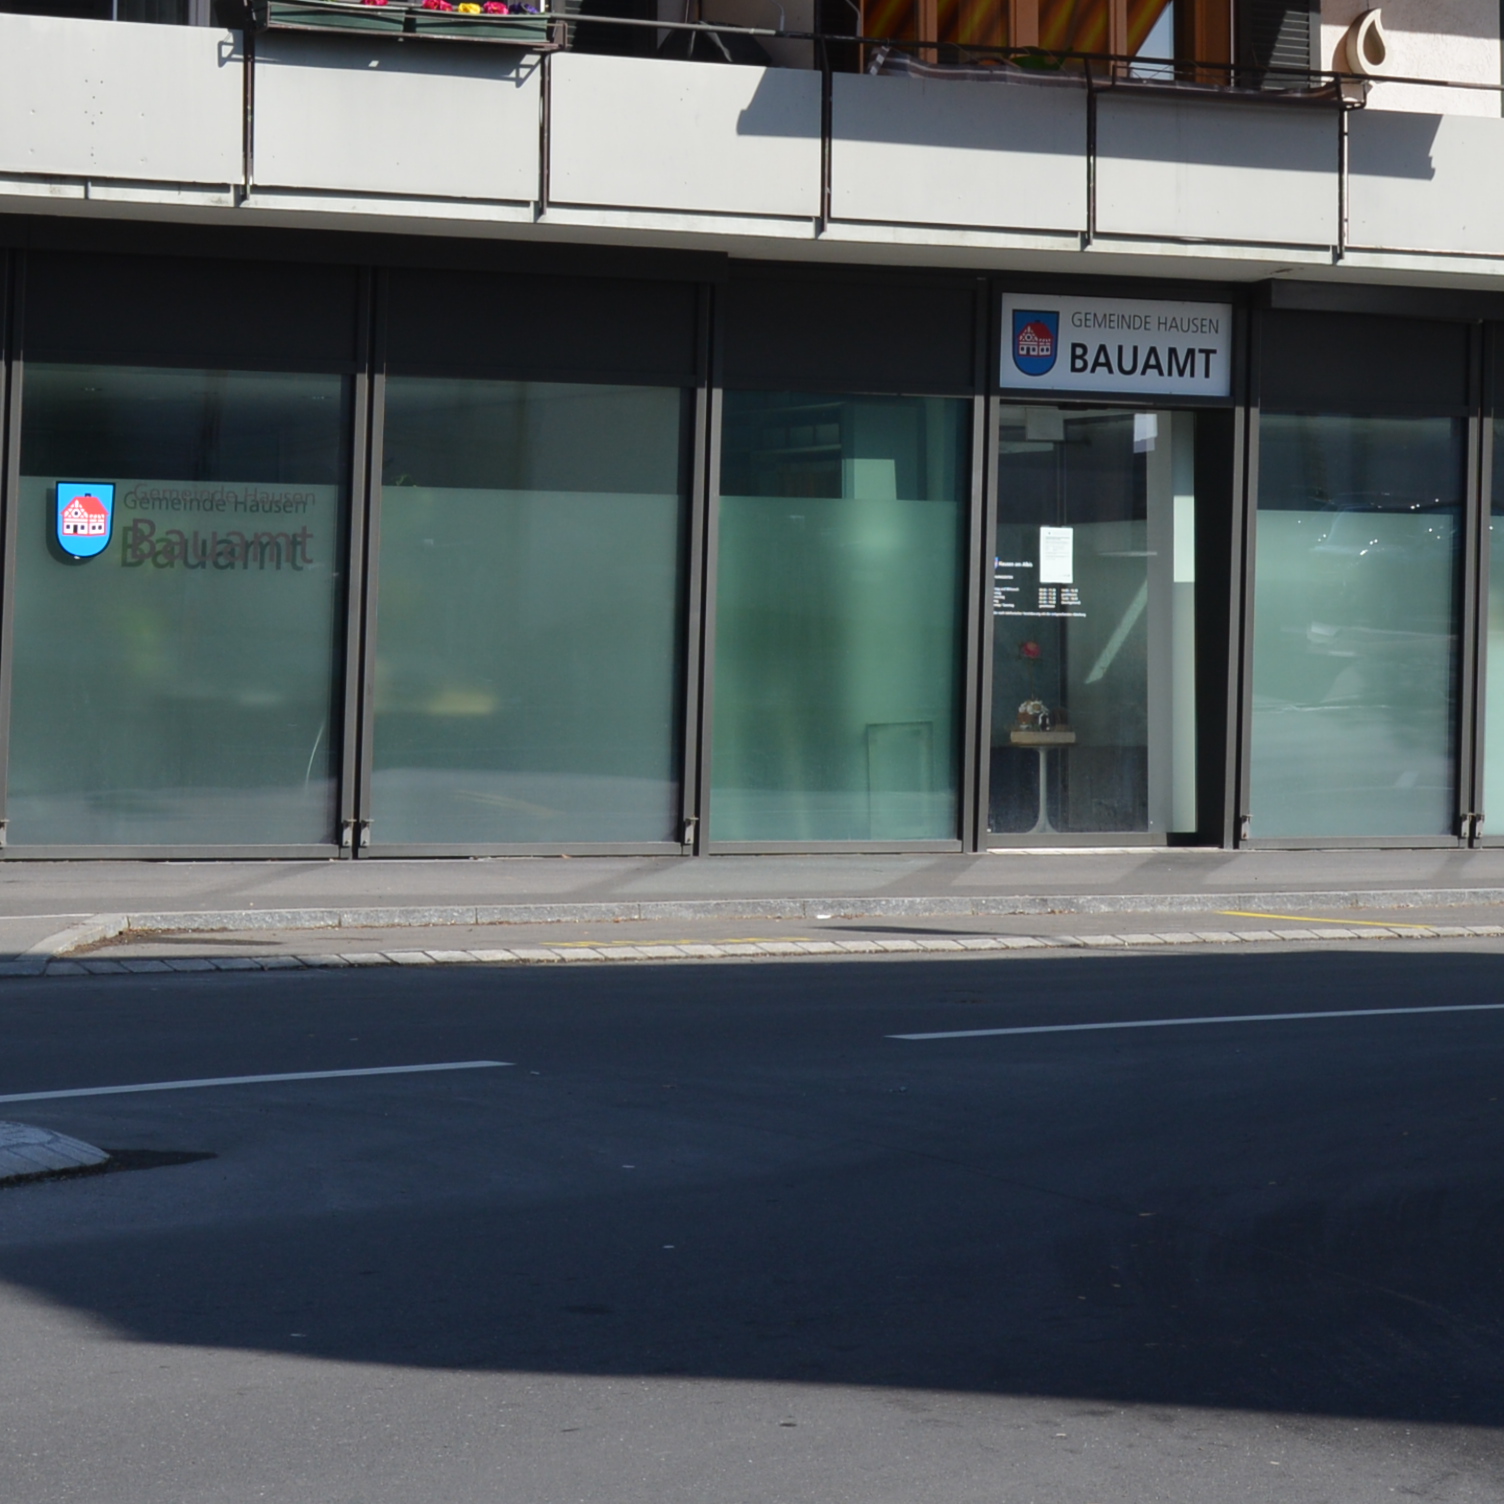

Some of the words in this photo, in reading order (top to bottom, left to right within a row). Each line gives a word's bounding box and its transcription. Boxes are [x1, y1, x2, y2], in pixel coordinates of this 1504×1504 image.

[1071, 311, 1151, 331] GEMEINDE
[1157, 316, 1219, 334] HAUSEN
[1070, 342, 1217, 379] BAUAMT
[131, 517, 314, 564] Bauamt
